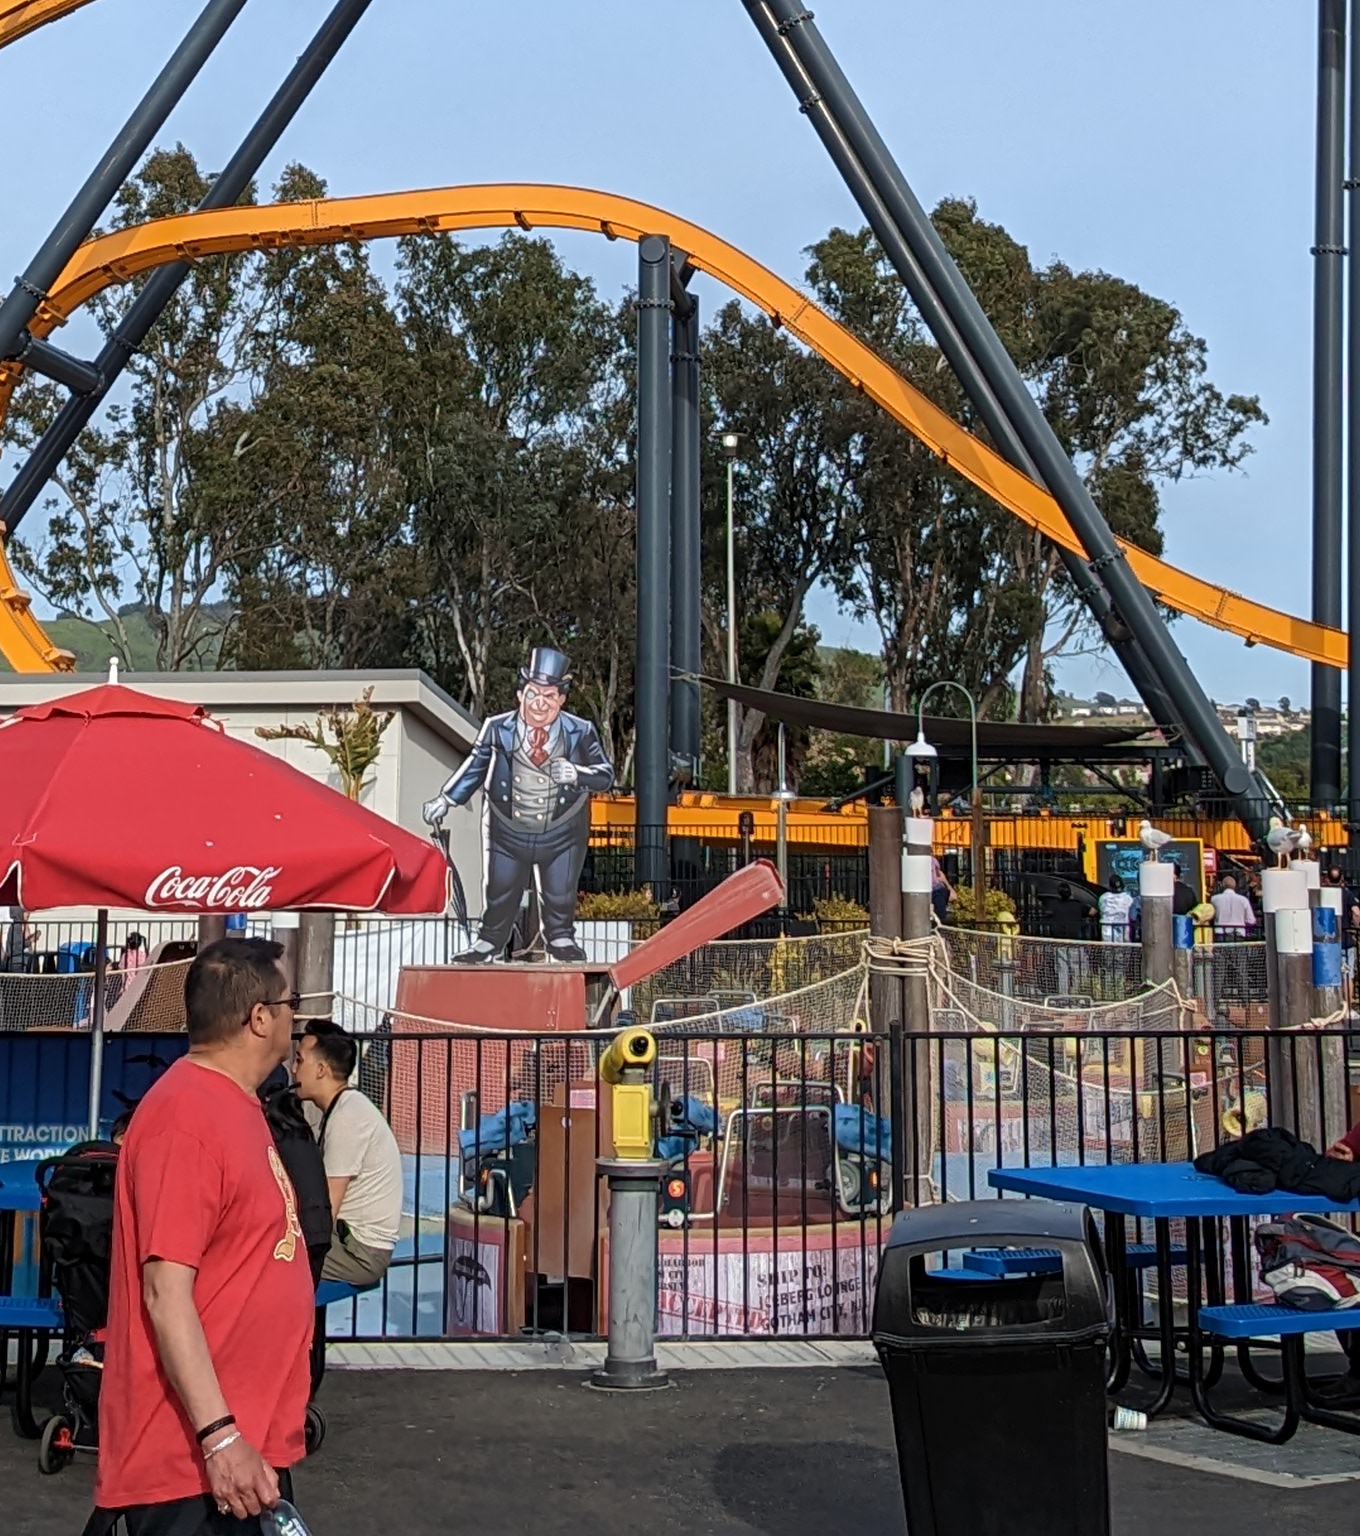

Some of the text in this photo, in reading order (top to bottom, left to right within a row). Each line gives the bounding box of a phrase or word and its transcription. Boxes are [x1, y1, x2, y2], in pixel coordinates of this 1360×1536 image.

[144, 866, 283, 908] Coca-Cola
[758, 1277, 861, 1310] ICBERG LONGE
